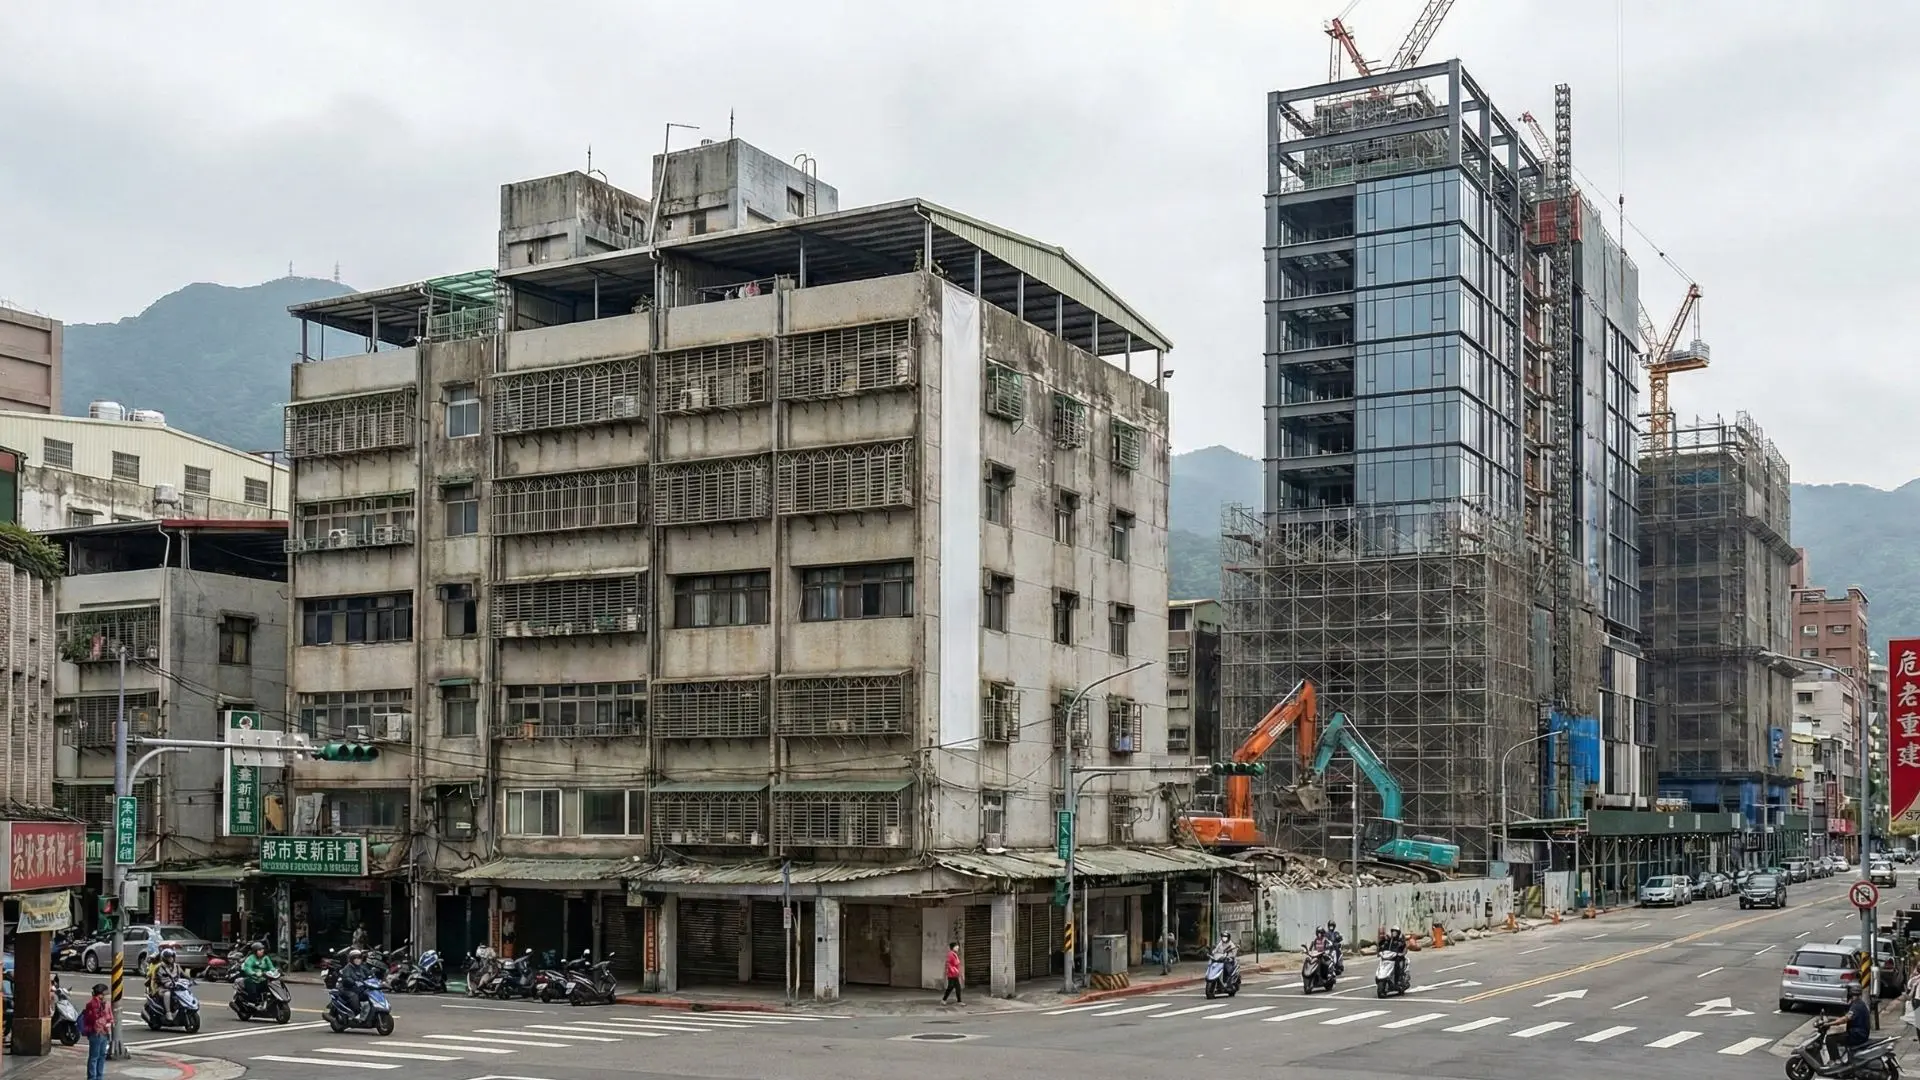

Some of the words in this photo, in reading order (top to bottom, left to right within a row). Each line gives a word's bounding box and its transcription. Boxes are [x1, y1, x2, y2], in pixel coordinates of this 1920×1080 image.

[1896, 650, 1920, 768] 危老重建
[262, 840, 359, 861] 都市更新計畫
